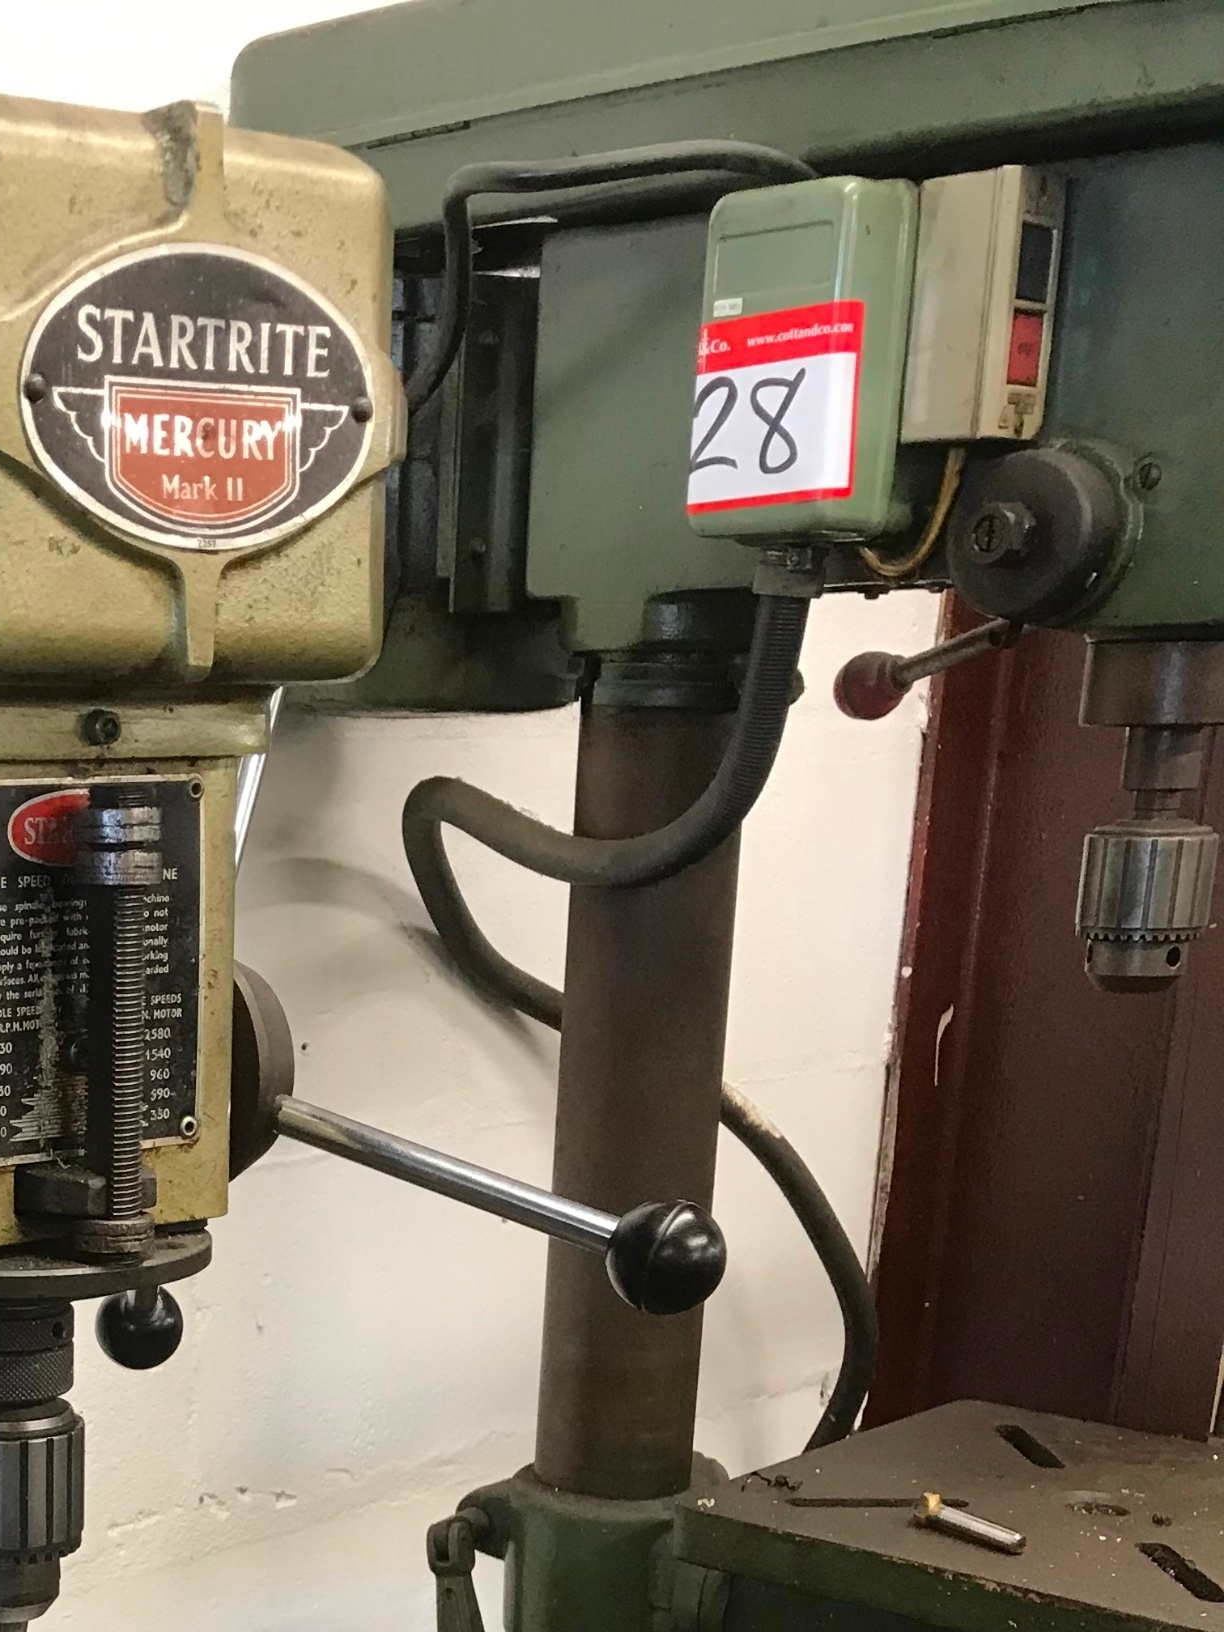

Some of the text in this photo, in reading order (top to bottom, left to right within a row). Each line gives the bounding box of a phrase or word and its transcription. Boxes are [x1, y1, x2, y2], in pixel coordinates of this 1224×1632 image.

[77, 304, 331, 378] STARTRITE
[690, 368, 806, 475] 28
[123, 411, 281, 461] MERCURY
[162, 474, 244, 502] Mark II
[17, 875, 51, 889] SPEED
[143, 893, 169, 903] chine
[153, 908, 169, 918] not
[17, 962, 23, 971] a
[6, 989, 20, 1001] the
[16, 1005, 43, 1017] SPEED
[151, 993, 182, 1005] SPEEDS
[153, 1008, 182, 1020] MOTOR
[144, 1027, 171, 1041] 2580
[145, 1046, 171, 1061] 1540
[149, 1068, 171, 1081] 960
